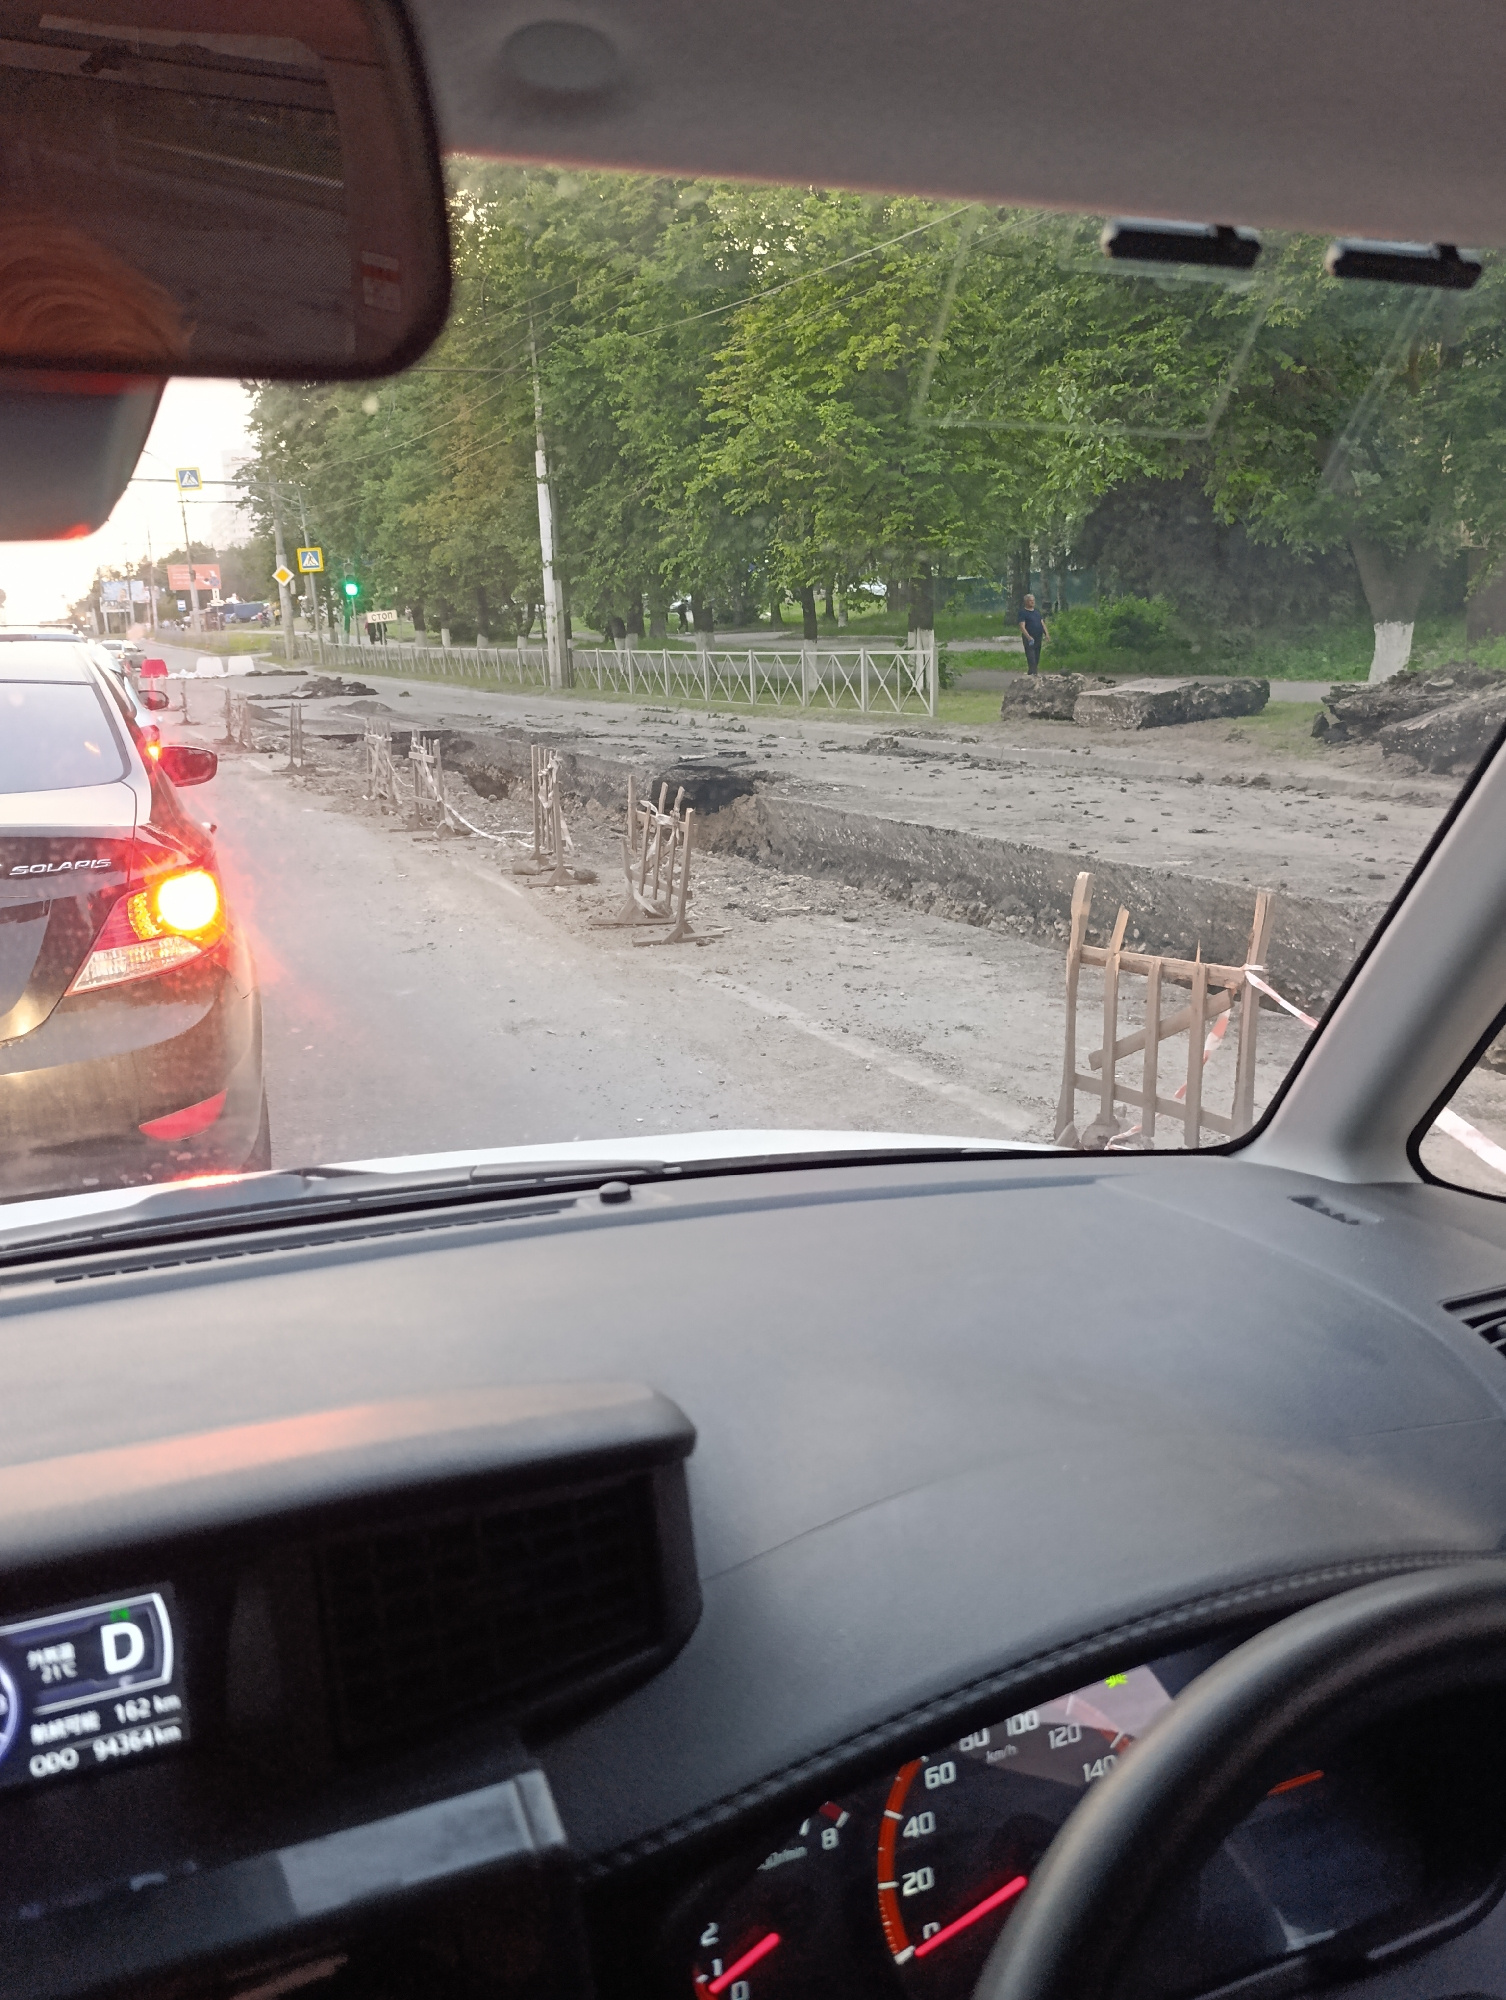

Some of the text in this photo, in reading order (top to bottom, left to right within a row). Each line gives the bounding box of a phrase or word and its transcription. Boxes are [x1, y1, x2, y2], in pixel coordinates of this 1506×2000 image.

[371, 611, 393, 622] СТОП
[9, 858, 112, 875] SOLARIS
[101, 1622, 145, 1674] D
[1005, 1709, 1039, 1737] 100
[1048, 1722, 1082, 1750] 120
[924, 1761, 956, 1790] 60
[821, 1827, 839, 1850] 8
[902, 1810, 937, 1839] 40
[902, 1866, 935, 1897] 20
[700, 1922, 720, 1947] 2
[711, 1957, 723, 1977] 1
